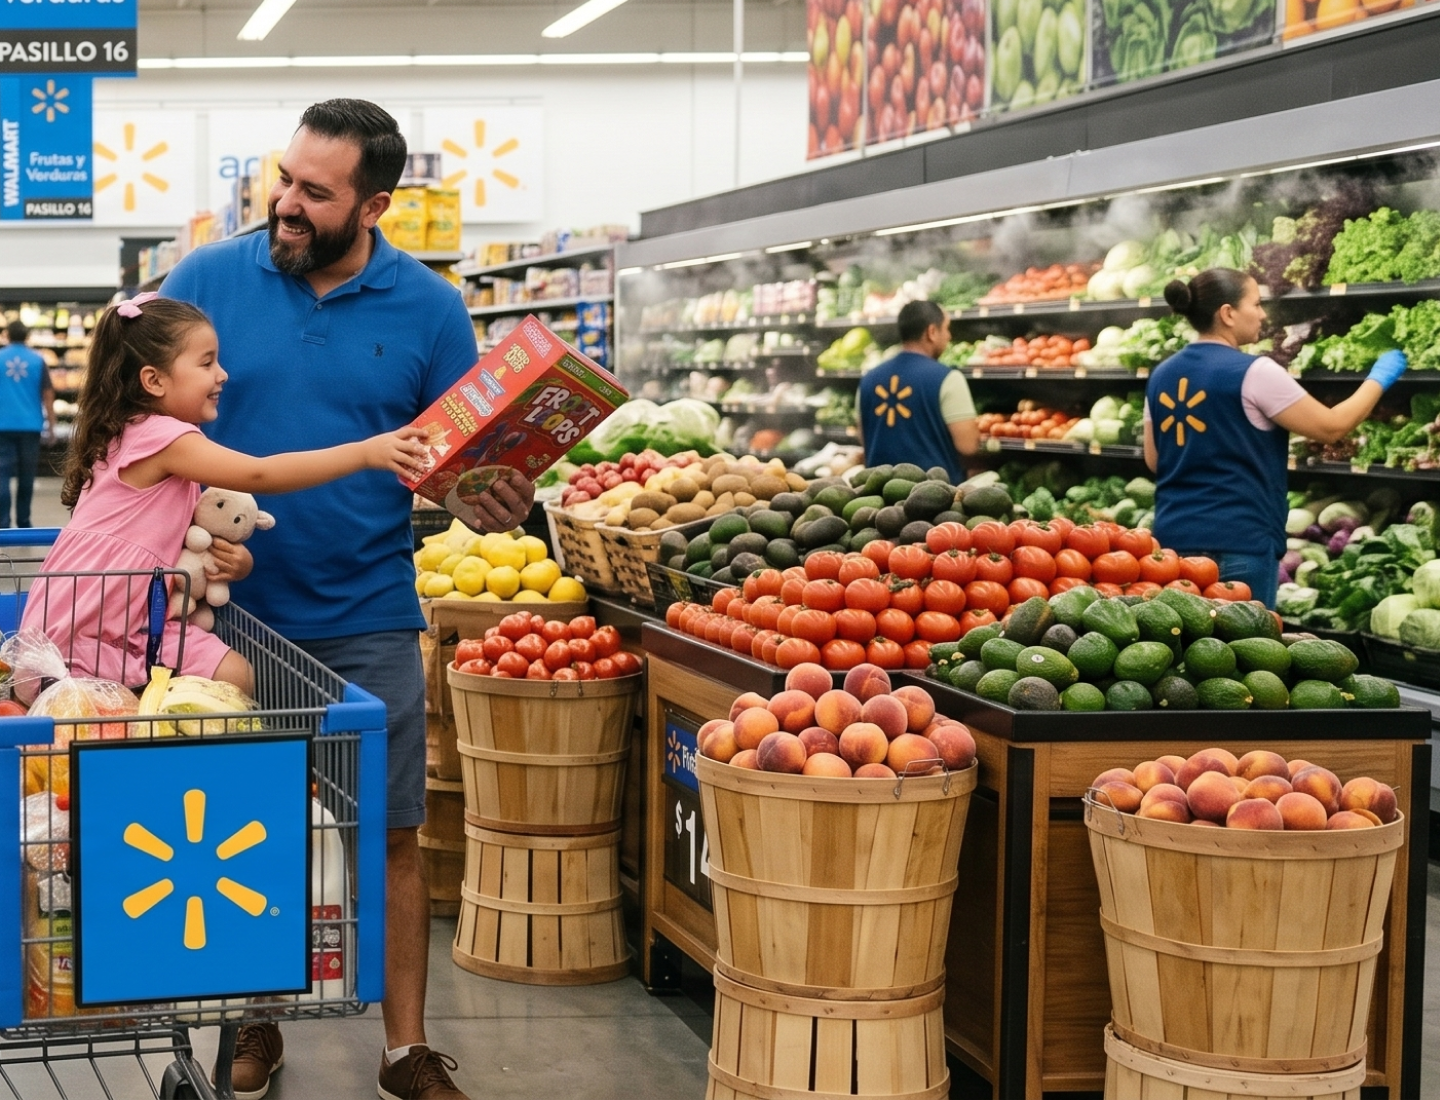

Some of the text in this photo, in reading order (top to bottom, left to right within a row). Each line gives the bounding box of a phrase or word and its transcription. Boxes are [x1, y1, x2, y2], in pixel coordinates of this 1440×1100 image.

[102, 41, 128, 62] 16
[2, 118, 19, 207] WALMART
[30, 151, 86, 170] Frutas y
[26, 202, 76, 216] PASILLO
